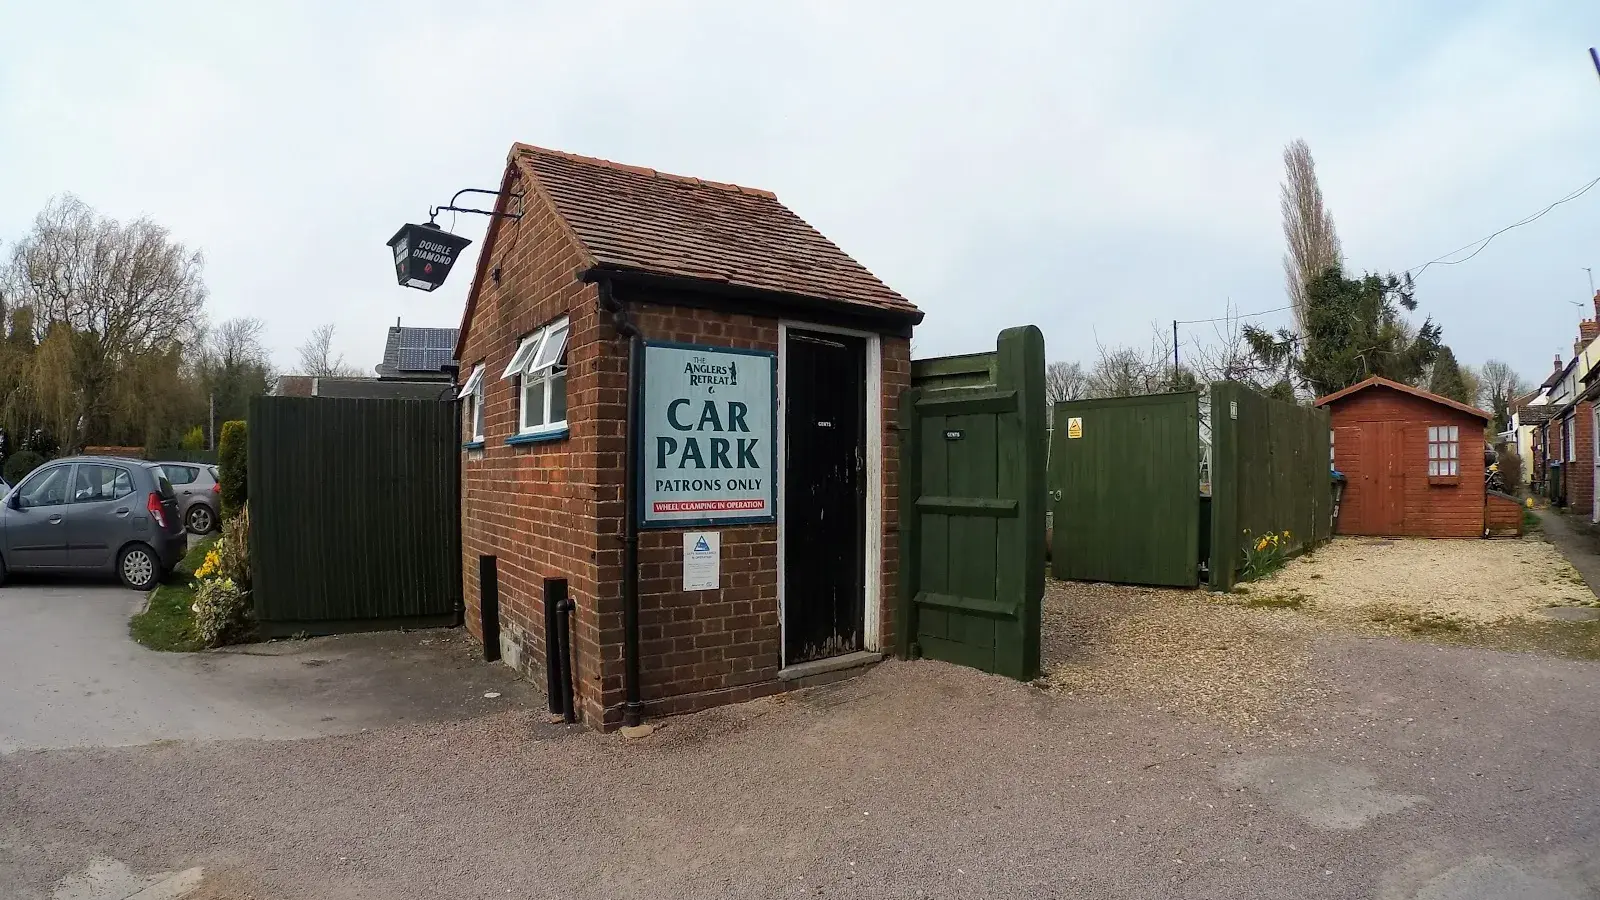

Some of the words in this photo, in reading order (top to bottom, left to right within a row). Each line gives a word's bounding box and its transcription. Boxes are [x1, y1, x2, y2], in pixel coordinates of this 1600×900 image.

[419, 240, 452, 255] DOUBLE
[412, 249, 452, 265] DIAMOND
[684, 362, 727, 375] ANGLERS
[690, 374, 729, 386] RETREAT
[667, 398, 751, 433] CAR
[656, 436, 761, 469] PARK
[655, 479, 722, 492] PATRONS
[726, 479, 762, 491] ONLY
[655, 503, 680, 511] WHEEL
[680, 502, 716, 510] CLAMPING
[726, 500, 763, 509] OPERATION
